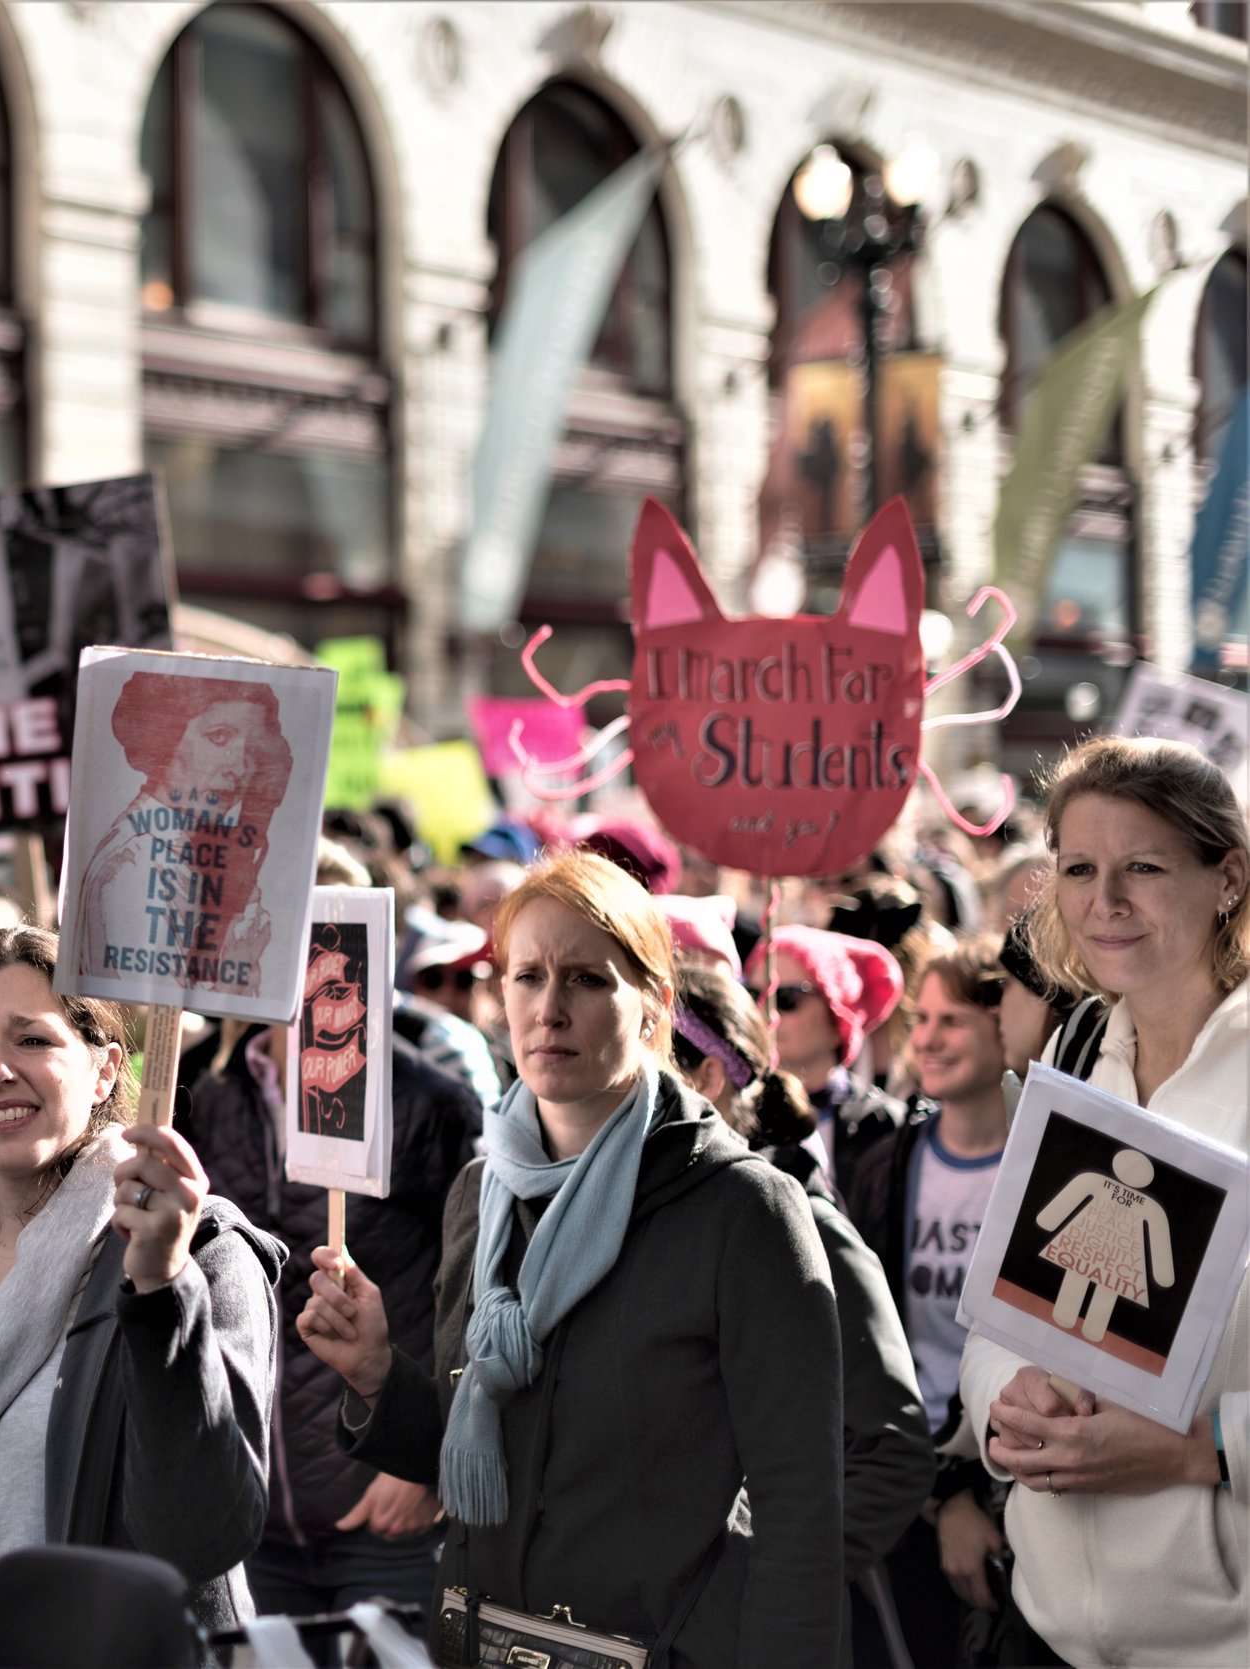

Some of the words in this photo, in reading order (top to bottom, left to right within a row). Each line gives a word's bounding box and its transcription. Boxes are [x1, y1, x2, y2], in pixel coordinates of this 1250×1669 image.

[644, 648, 668, 699] I
[691, 709, 914, 792] Students
[188, 786, 198, 802] A
[127, 807, 258, 849] WOMAN'S
[150, 836, 228, 869] PLACE
[147, 867, 177, 902] IS
[188, 872, 224, 907] IN
[145, 905, 222, 951] THE
[103, 943, 252, 986] RESISTANCE
[314, 1005, 332, 1026] OUR
[303, 1055, 326, 1079] OUR
[325, 1044, 357, 1084] POWER
[1095, 1197, 1142, 1223] UNITY
[1103, 1180, 1121, 1194] IT'S
[1122, 1188, 1146, 1206] TIME
[1111, 1193, 1133, 1208] FOR
[1076, 1217, 1140, 1254] JUSTICE
[1087, 1206, 1140, 1239] PEACE
[1058, 1234, 1143, 1284] RESPECT
[1069, 1226, 1142, 1267] DIGNITY
[1045, 1244, 1146, 1301] EQUALITY
